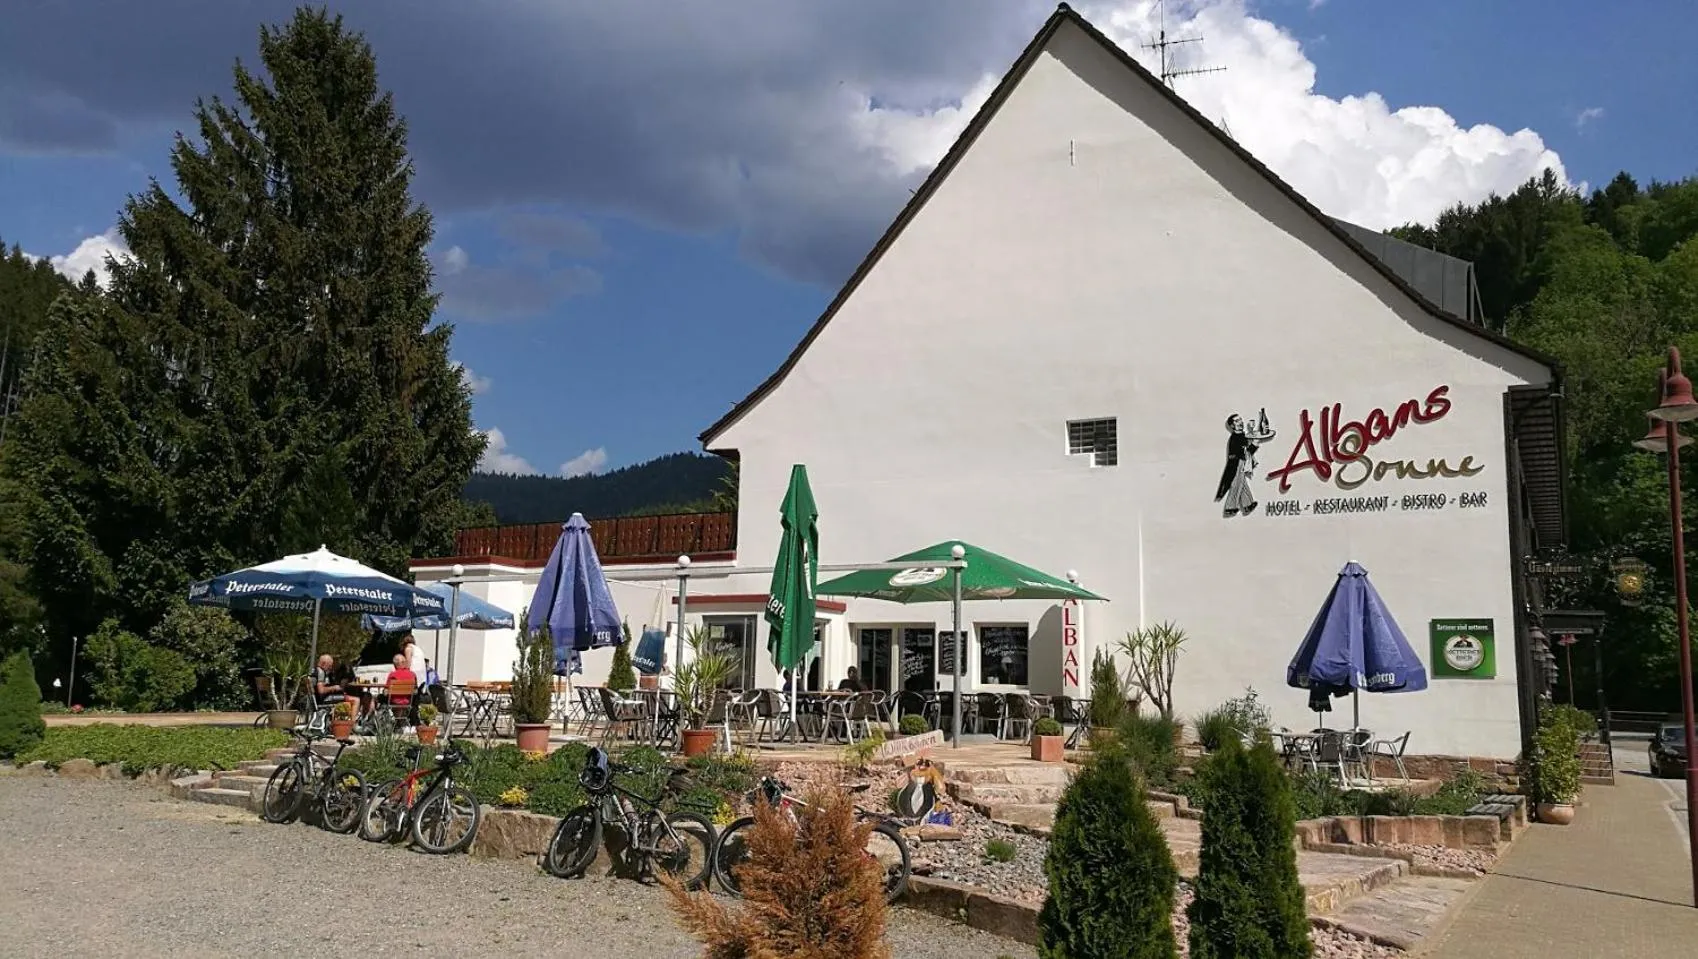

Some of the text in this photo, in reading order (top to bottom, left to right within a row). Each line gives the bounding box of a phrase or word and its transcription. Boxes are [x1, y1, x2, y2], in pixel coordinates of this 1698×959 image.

[1266, 385, 1452, 494] Albans
[1335, 434, 1485, 490] Sonne
[1265, 501, 1301, 516] HOTEL
[1313, 496, 1390, 515] RESTAURANT
[1401, 493, 1447, 510] BISTRO
[1459, 491, 1488, 508] BAR
[225, 580, 296, 595] Peterstaler
[325, 583, 393, 601] Peterstaler
